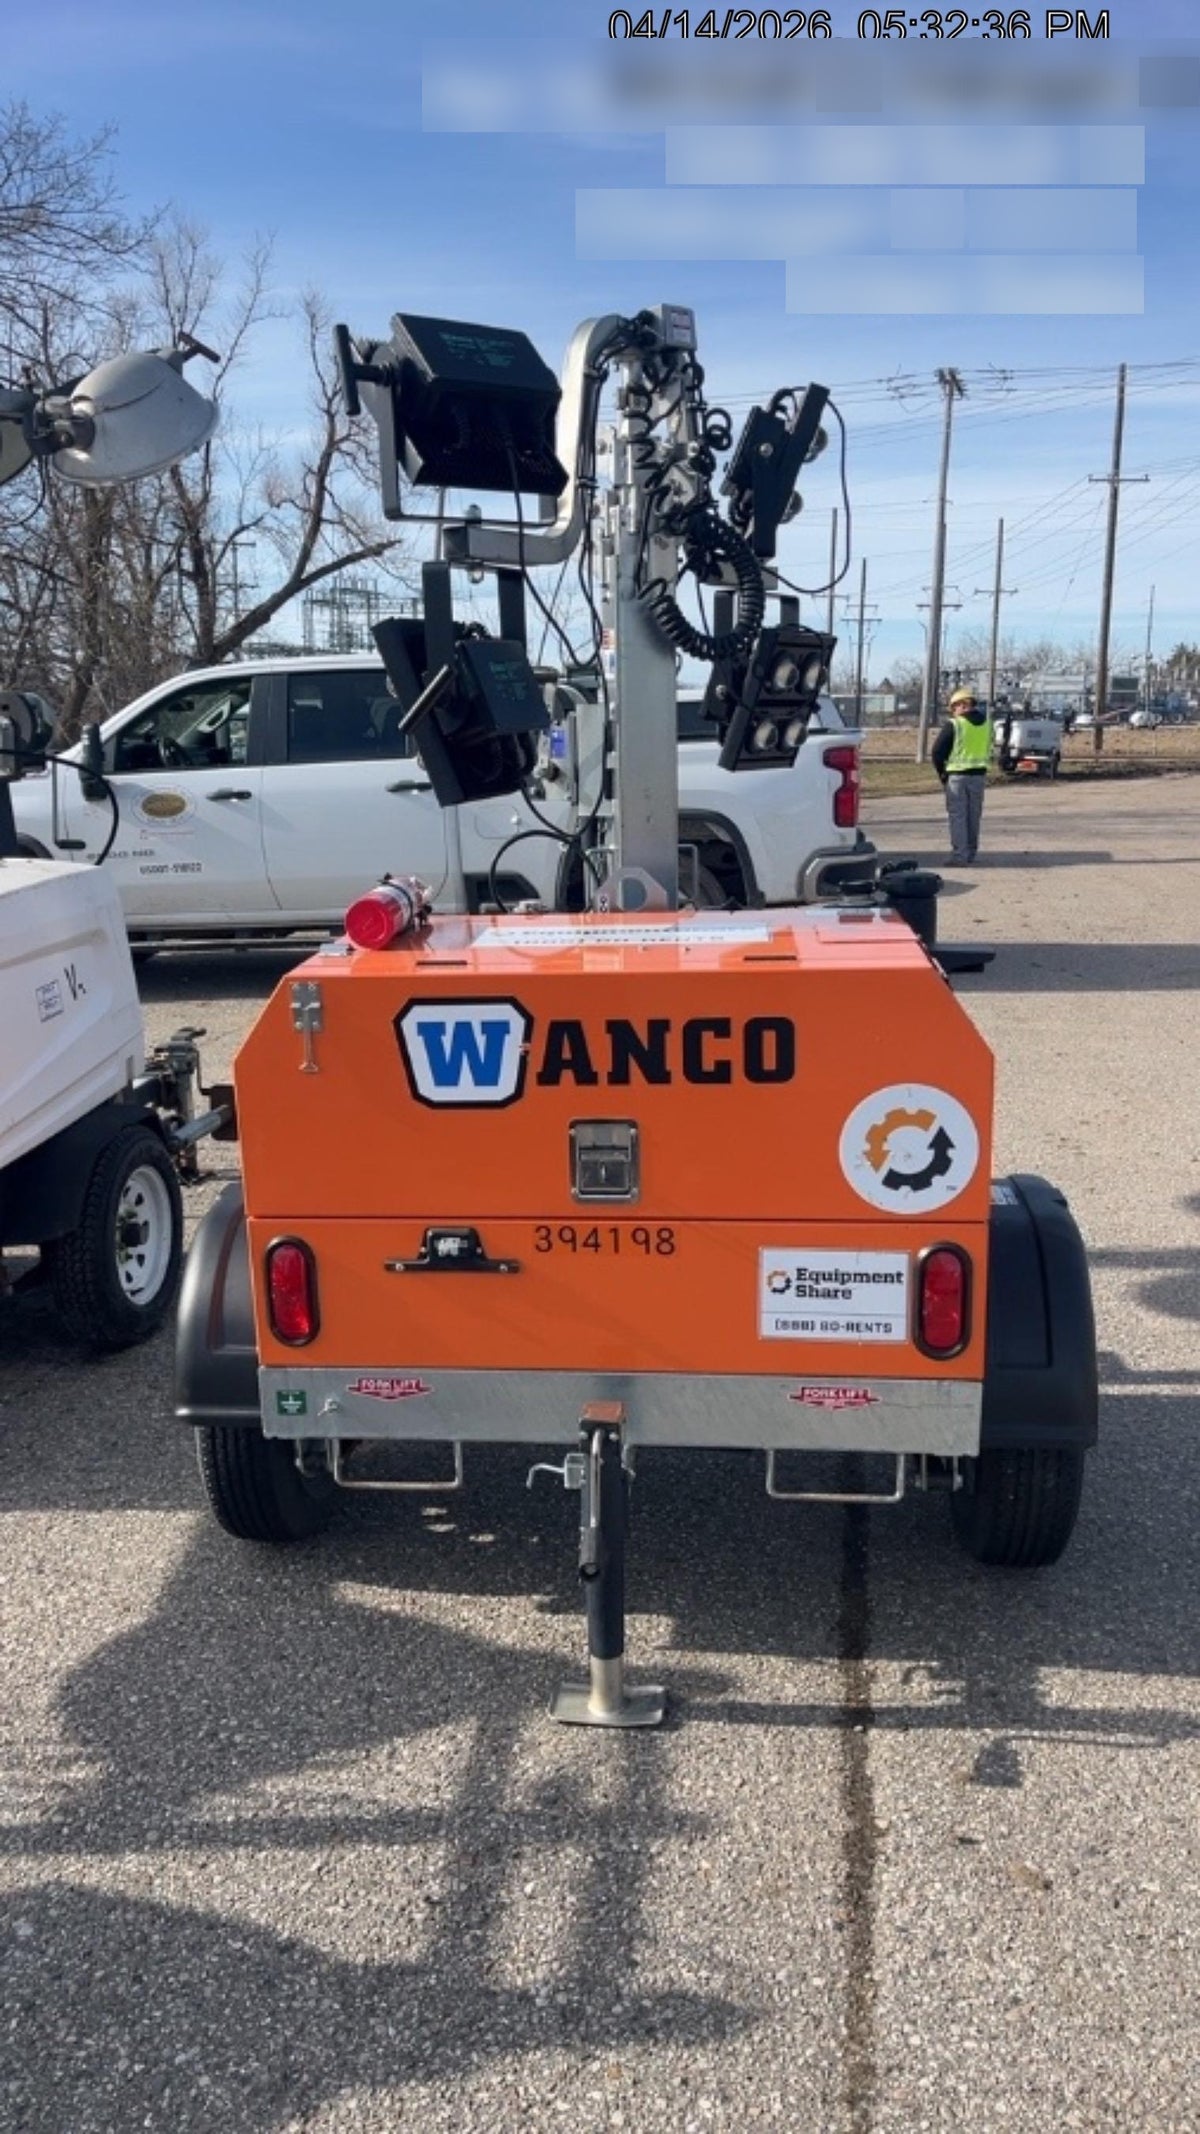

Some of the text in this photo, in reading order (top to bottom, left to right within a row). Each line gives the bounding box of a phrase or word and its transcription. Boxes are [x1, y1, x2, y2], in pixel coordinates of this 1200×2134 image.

[416, 1016, 796, 1086] WANCO
[534, 1226, 676, 1256] 394198
[796, 1267, 905, 1286] Equipment
[796, 1284, 853, 1300] Share
